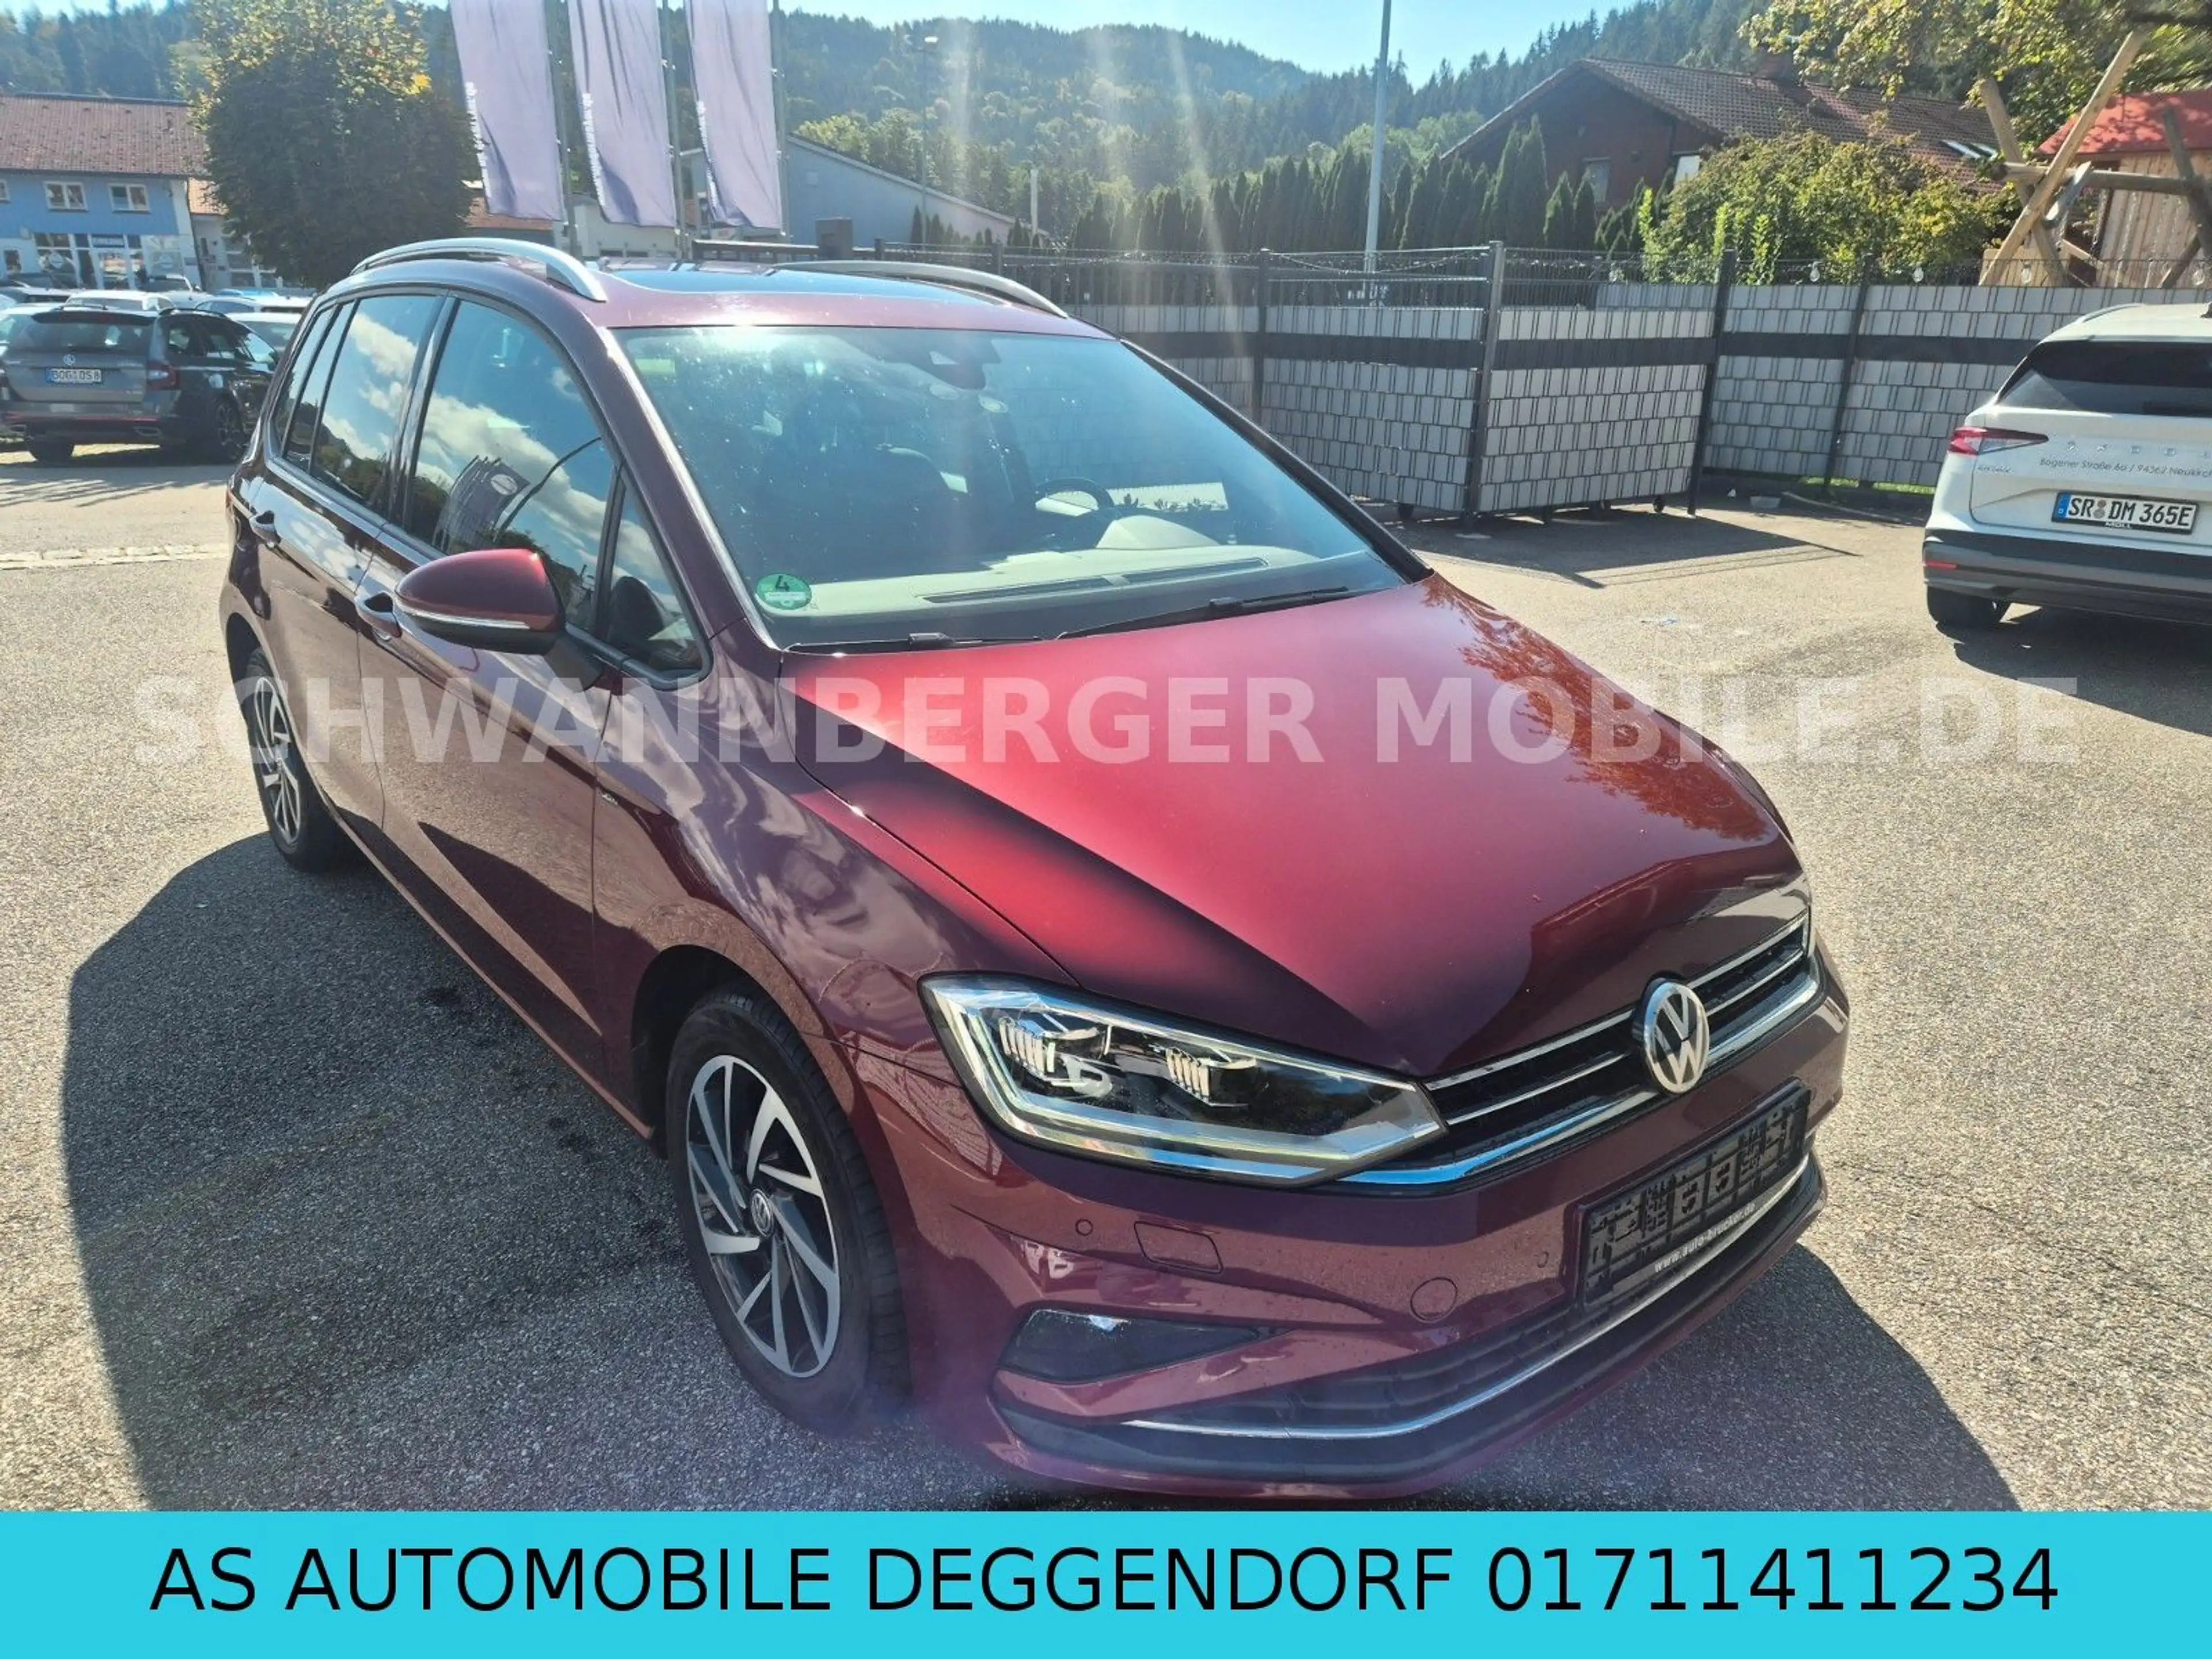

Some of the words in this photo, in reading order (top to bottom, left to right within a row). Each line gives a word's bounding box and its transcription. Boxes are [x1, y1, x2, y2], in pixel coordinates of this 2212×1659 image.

[2068, 498, 2095, 518] SR
[2108, 501, 2137, 521] DM
[2139, 503, 2193, 527] 365E
[775, 575, 790, 592] 4
